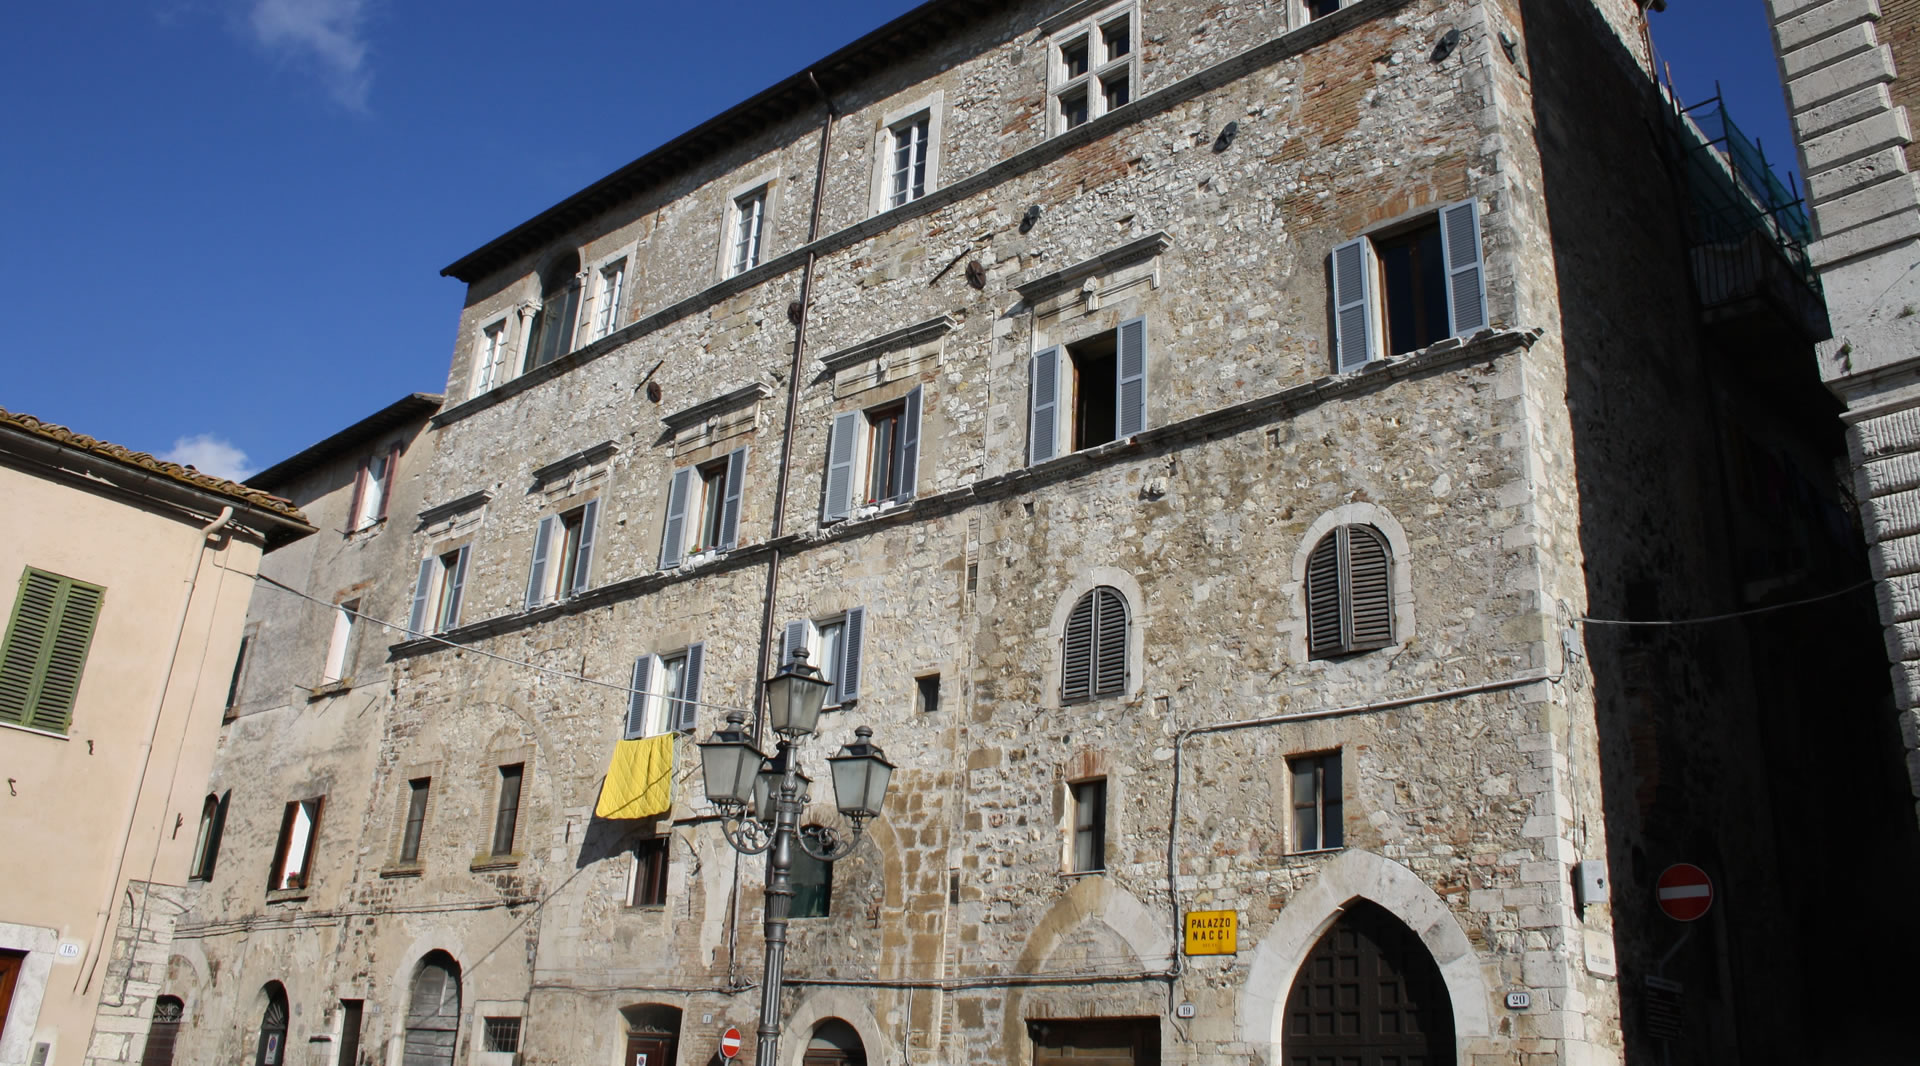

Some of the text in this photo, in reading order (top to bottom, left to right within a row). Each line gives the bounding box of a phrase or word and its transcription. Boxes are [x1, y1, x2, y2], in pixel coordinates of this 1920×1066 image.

[1191, 918, 1231, 928] PALAZZO
[1192, 930, 1230, 940] NACCI
[1512, 995, 1525, 1005] 20
[1182, 1006, 1191, 1015] 19
